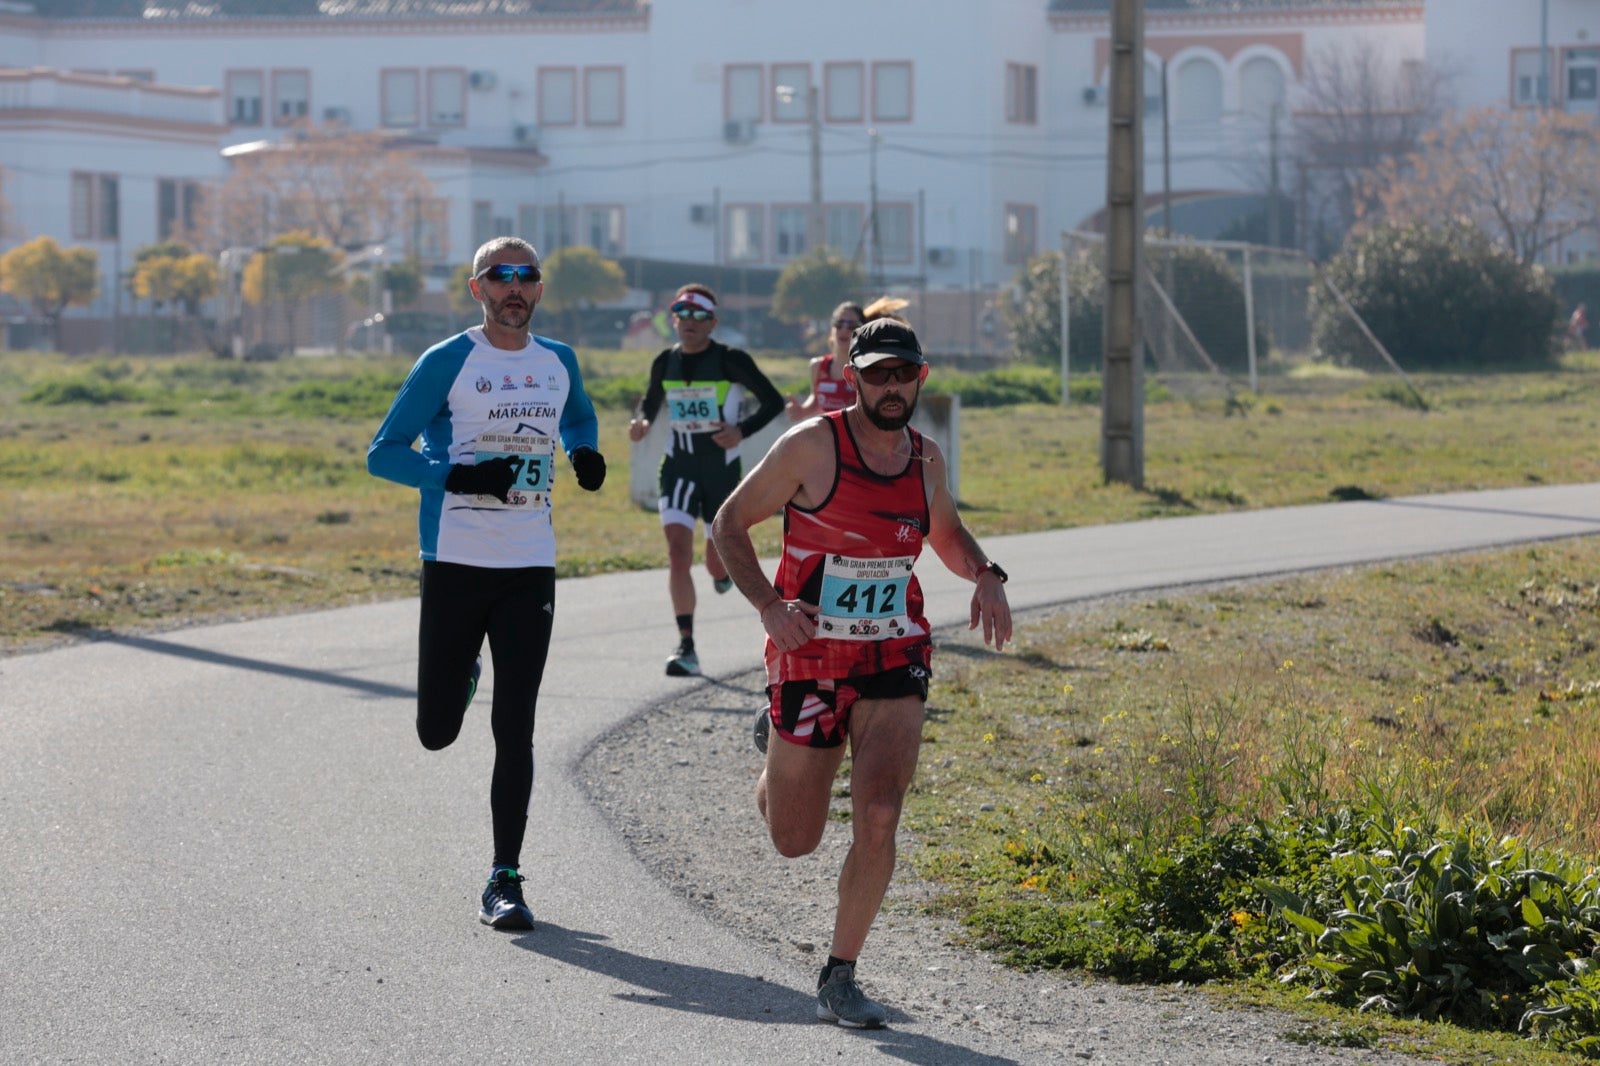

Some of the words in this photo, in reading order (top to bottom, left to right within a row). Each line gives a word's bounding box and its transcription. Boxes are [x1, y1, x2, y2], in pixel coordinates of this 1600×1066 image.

[488, 406, 556, 420] MARACENA
[676, 401, 710, 418] 346
[497, 435, 511, 443] GRAN
[511, 436, 529, 444] PREMIO
[503, 444, 532, 452] DIPUTACIÓN
[508, 458, 541, 486] 75
[850, 560, 866, 569] GRAN
[866, 560, 887, 569] PREMIO
[887, 560, 894, 568] DE
[857, 569, 889, 578] DIPUTACIÓN
[836, 584, 897, 613] 412
